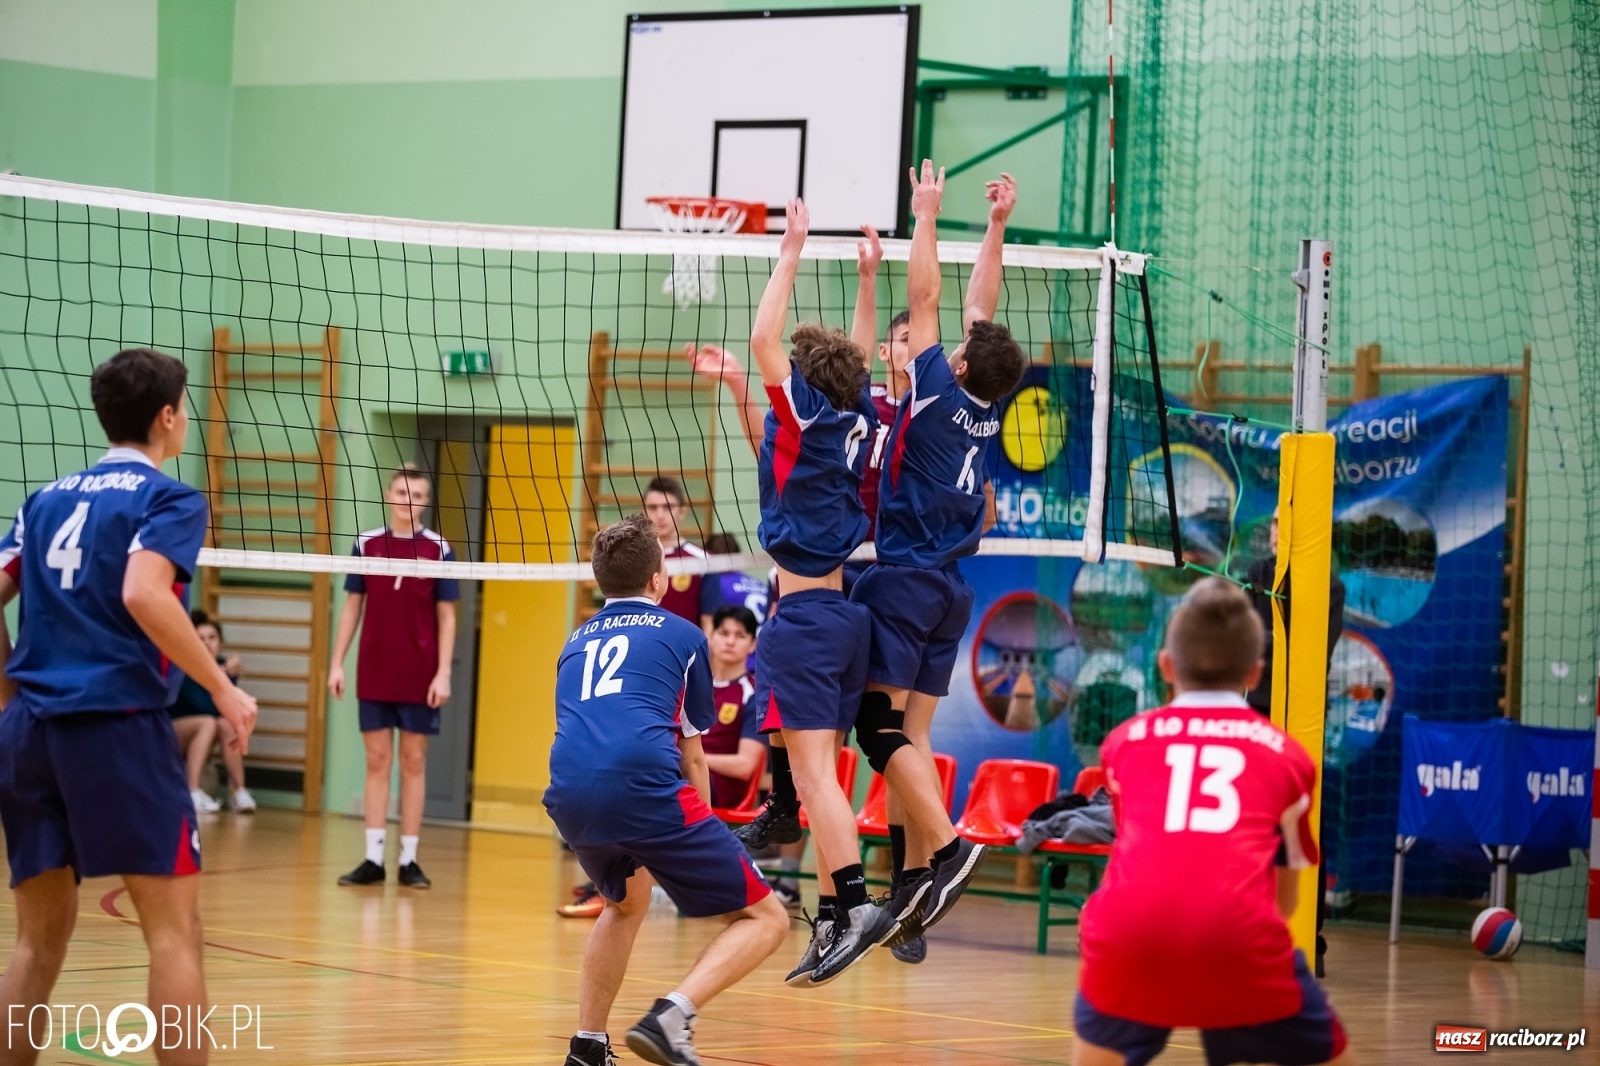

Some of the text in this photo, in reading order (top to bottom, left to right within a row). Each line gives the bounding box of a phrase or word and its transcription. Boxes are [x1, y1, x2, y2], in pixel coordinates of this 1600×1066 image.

[1327, 408, 1417, 444] reacji
[46, 501, 91, 590] 4
[569, 612, 666, 643] II LO RACIBÓRZ
[580, 634, 630, 702] 12
[1153, 716, 1183, 738] LO
[1163, 743, 1247, 834] 13
[1416, 760, 1480, 798] gala
[1526, 767, 1585, 804] gala
